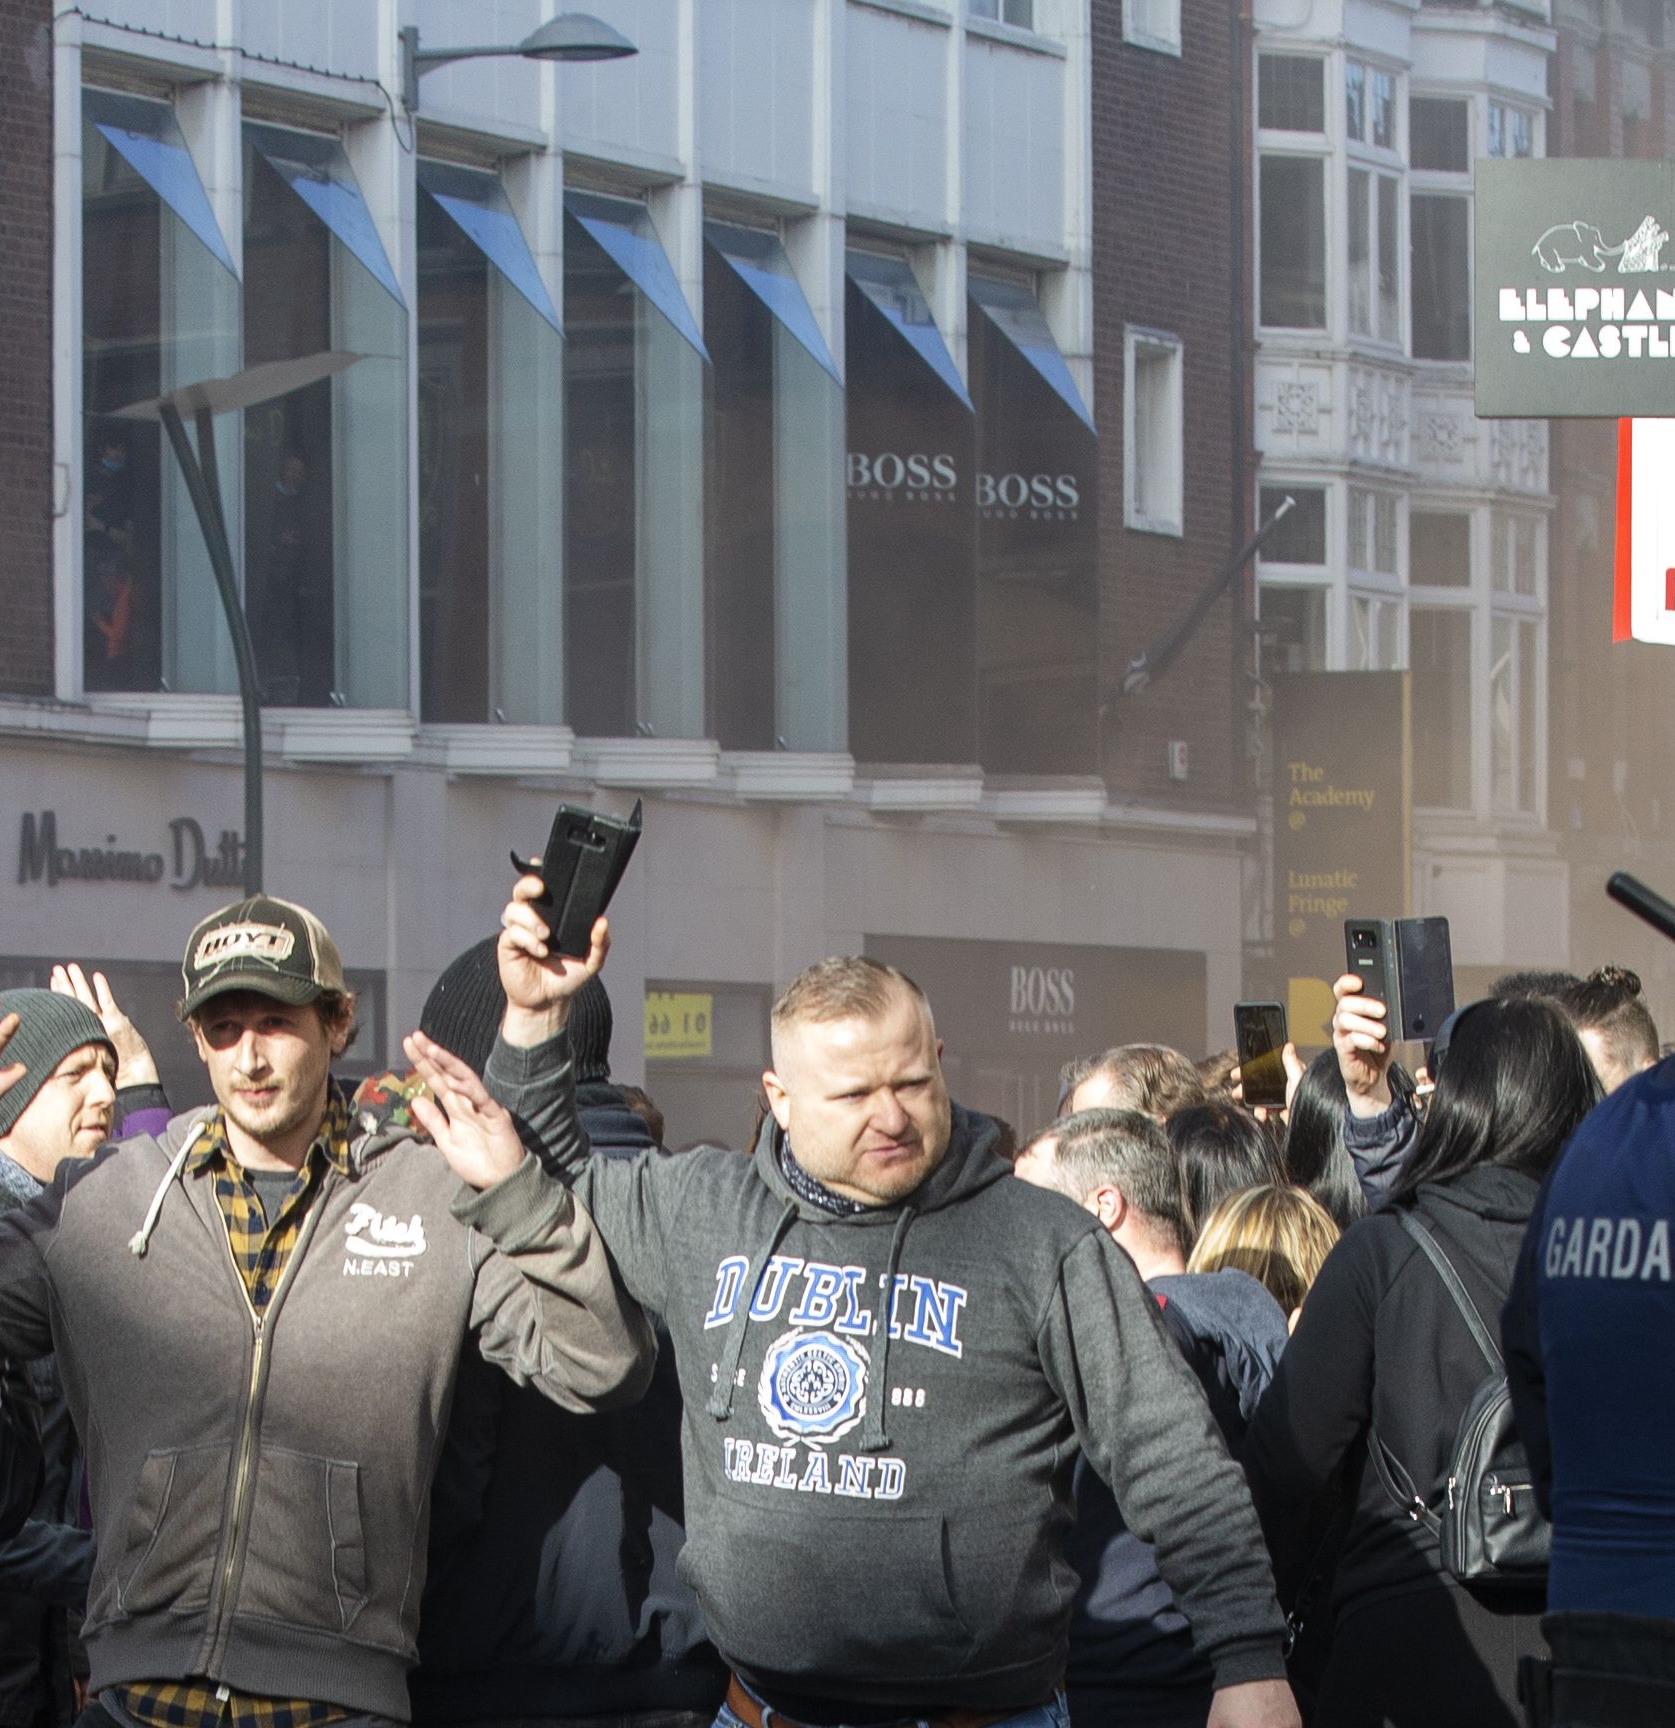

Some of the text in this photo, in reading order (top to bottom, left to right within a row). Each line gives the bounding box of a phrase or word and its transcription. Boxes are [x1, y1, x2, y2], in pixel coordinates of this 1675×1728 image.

[1513, 329, 1531, 354] &
[846, 453, 957, 489] BOSS
[976, 473, 1080, 508] BOSS
[1288, 762, 1324, 783] The
[1289, 787, 1375, 811] Academy
[17, 810, 246, 891] Massimo Dutt
[1288, 869, 1359, 889] Lunatic
[1288, 895, 1350, 918] Fringe
[1010, 965, 1074, 1016] BOSS
[1544, 1216, 1672, 1282] GARDA
[704, 1254, 968, 1359] DUBLIN
[723, 1437, 907, 1500] IRELAND
